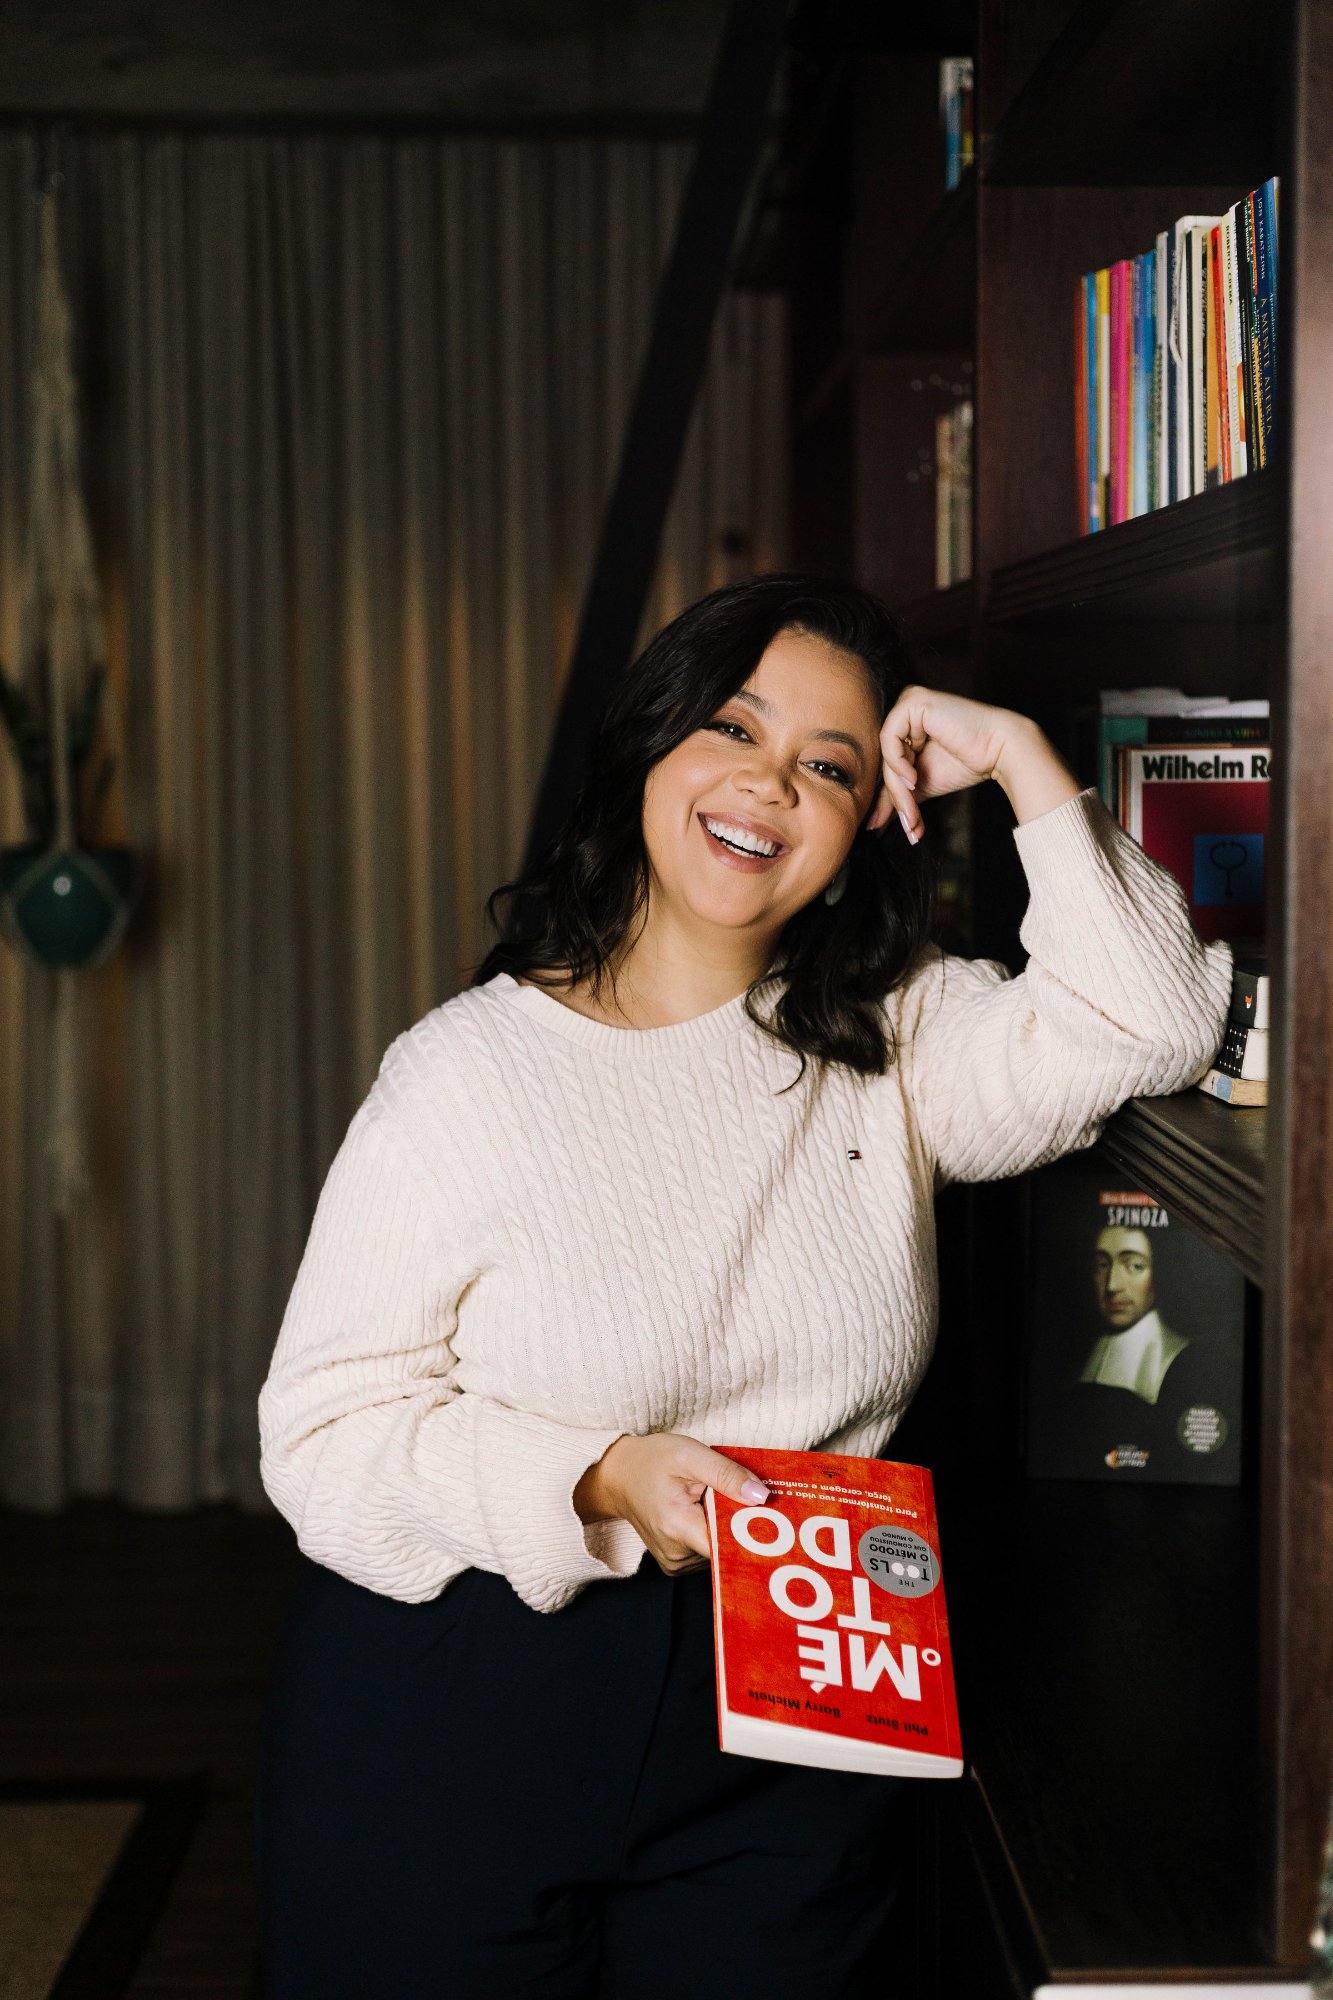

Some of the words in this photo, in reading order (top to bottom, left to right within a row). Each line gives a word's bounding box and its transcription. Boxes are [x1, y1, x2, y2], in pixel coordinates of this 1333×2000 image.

[1261, 313, 1270, 369] MENTE
[1263, 377, 1273, 436] ALERTA
[1142, 755, 1244, 779] Wilhelm
[1107, 1206, 1169, 1228] SPINOZA
[795, 1491, 816, 1502] vida
[821, 1483, 862, 1498] coragem
[865, 1489, 891, 1503] força,
[819, 1495, 835, 1503] sua
[838, 1496, 893, 1513] transformar
[895, 1507, 917, 1519] Para
[730, 1507, 852, 1571] DO
[869, 1536, 913, 1550] CONQUISTOU
[882, 1532, 906, 1542] MUNDO
[869, 1543, 917, 1561] MÉTODO
[915, 1544, 927, 1552] QUE
[920, 1553, 929, 1562] O
[899, 1579, 915, 1588] THE
[769, 1564, 891, 1636] TO
[797, 1624, 922, 1701] MÉ
[748, 1690, 800, 1710] Michels
[805, 1700, 840, 1718] Barry
[866, 1715, 899, 1730] Stutz
[904, 1721, 928, 1735] Phil
